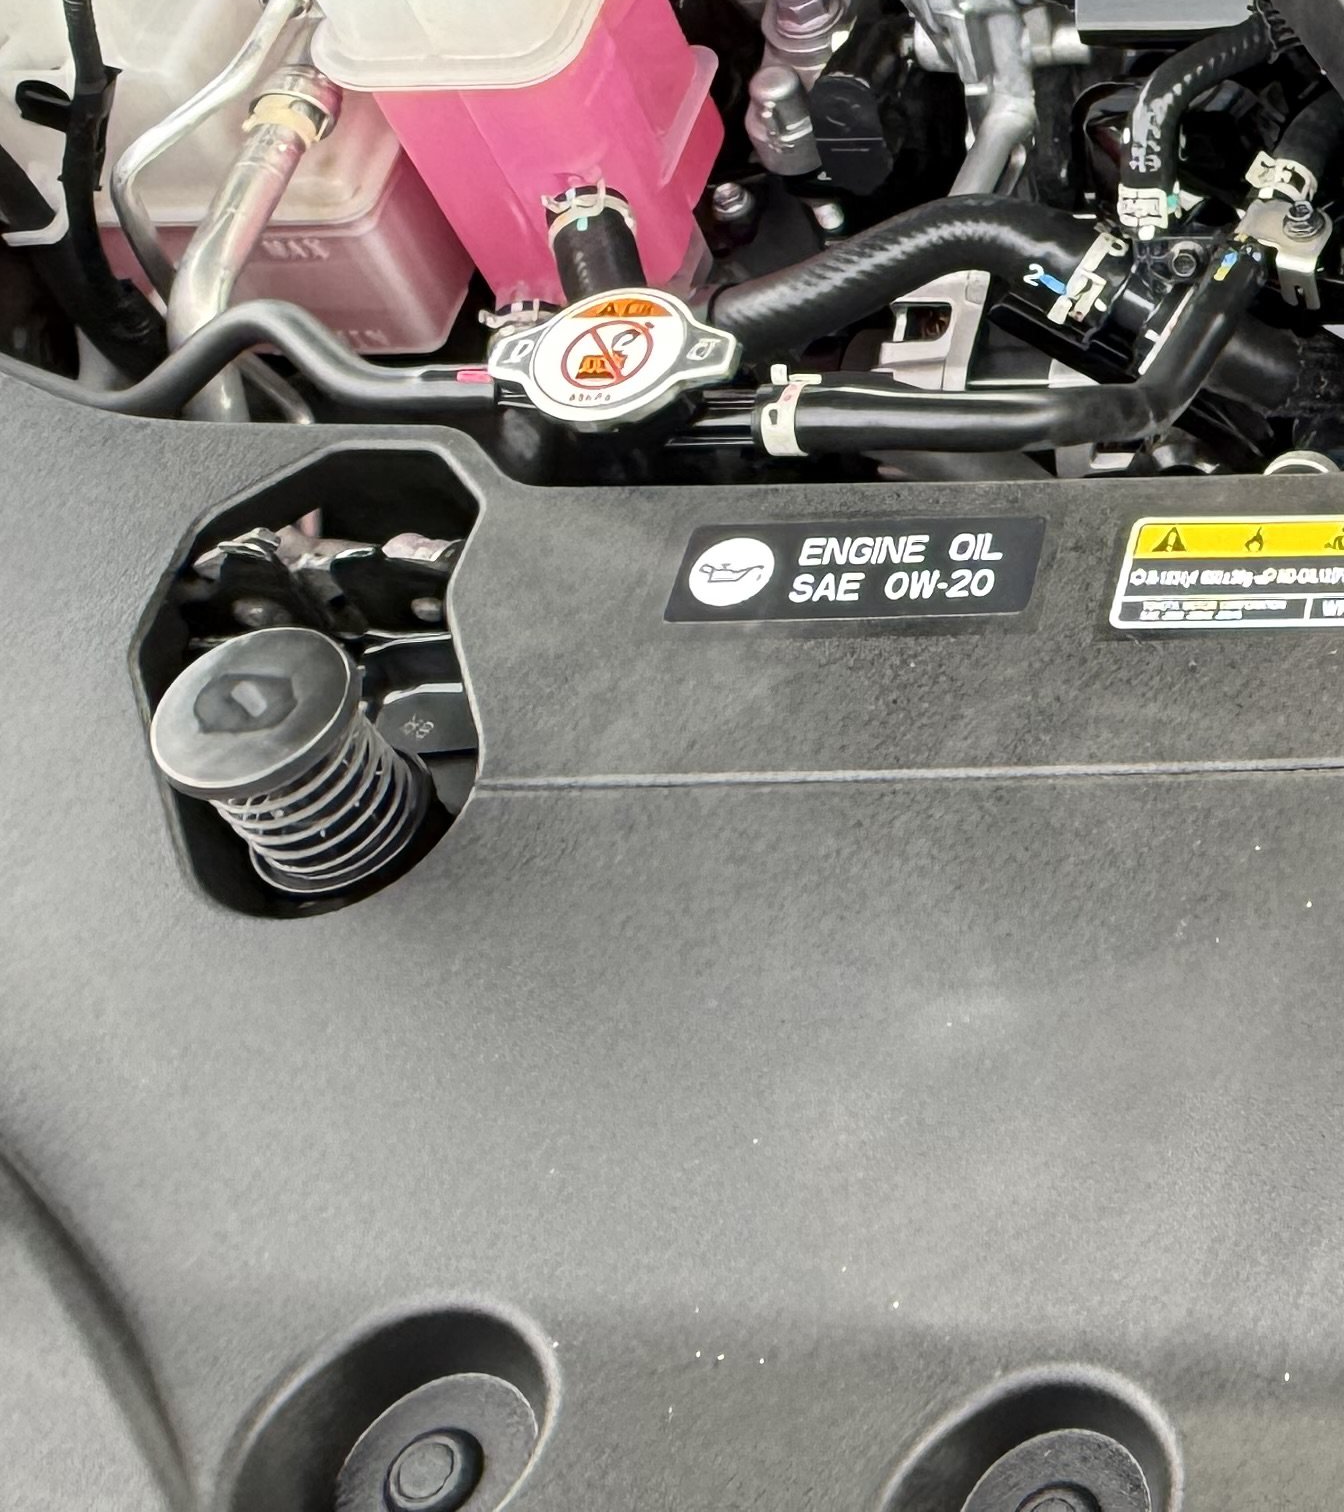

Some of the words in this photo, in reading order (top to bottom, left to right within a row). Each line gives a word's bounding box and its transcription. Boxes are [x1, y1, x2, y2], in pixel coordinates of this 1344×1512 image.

[798, 533, 930, 566] ENGINE
[947, 531, 1003, 561] OIL
[788, 571, 866, 603] SAE
[883, 567, 996, 602] 0W-20
